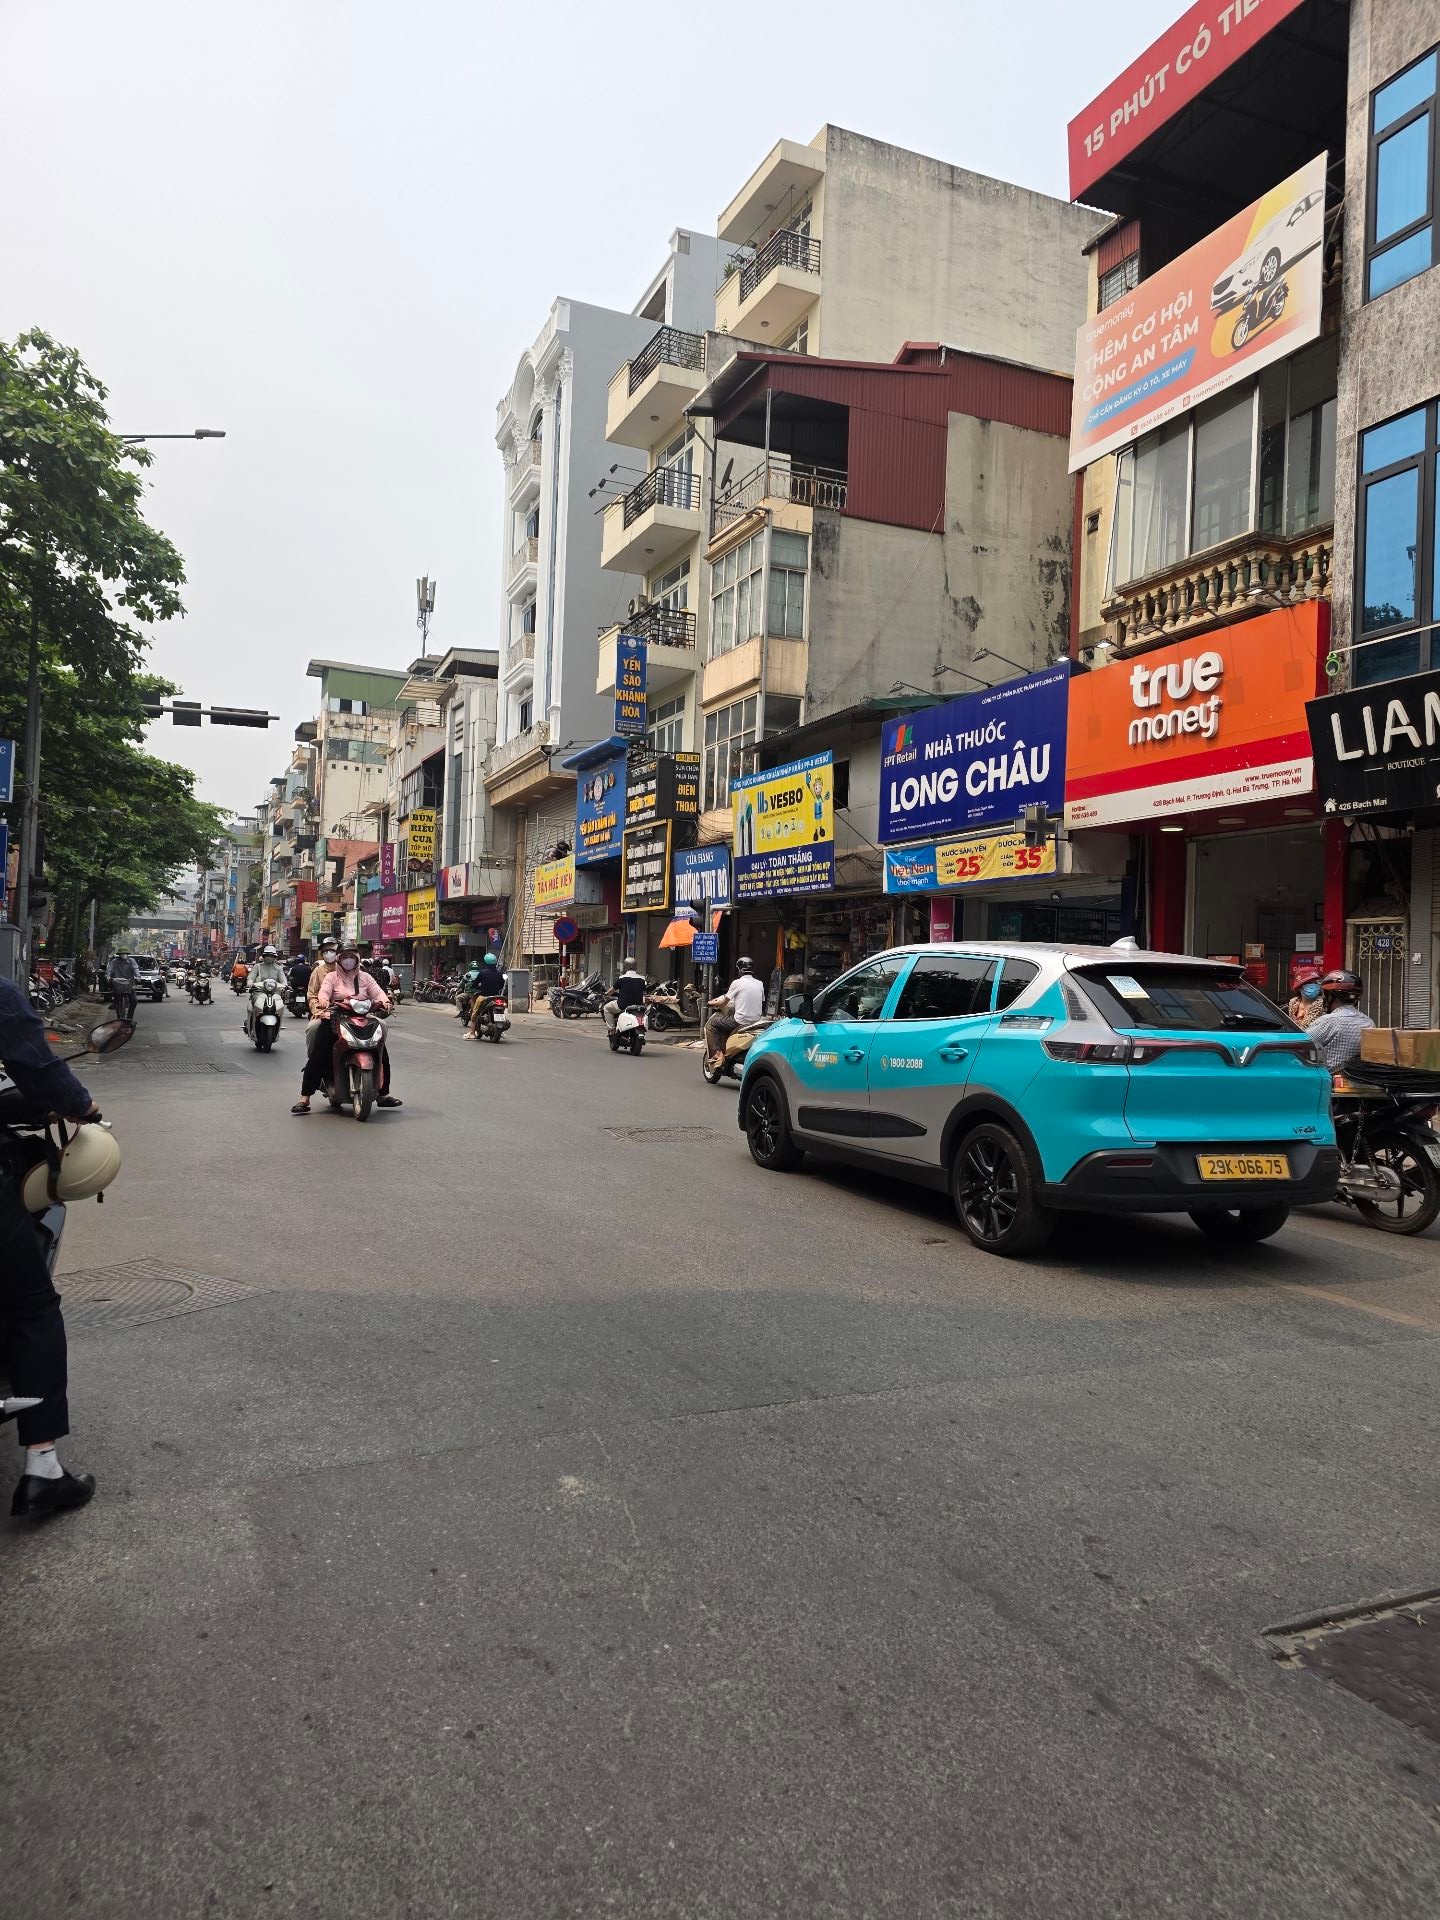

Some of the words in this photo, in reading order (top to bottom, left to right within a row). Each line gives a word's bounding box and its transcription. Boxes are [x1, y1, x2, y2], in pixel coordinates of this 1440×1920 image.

[1083, 122, 1105, 158] 15
[1109, 63, 1169, 137] PHÚT
[1175, 23, 1212, 75] CÓ
[1084, 333, 1128, 373] THÊM
[1131, 311, 1156, 343] CƠ
[1160, 289, 1193, 326] HỘI
[1082, 362, 1127, 402] CỘNG
[1130, 344, 1156, 374] AN
[1160, 315, 1199, 353] TÂM
[1161, 368, 1171, 380] XE
[623, 654, 641, 672] YẾN
[622, 672, 642, 687] SÀO
[1128, 651, 1224, 708] true
[616, 688, 647, 703] KHÁNH
[621, 702, 640, 719] HÒA
[1128, 694, 1223, 746] money
[924, 734, 954, 761] NHÀ
[955, 717, 1007, 752] THUỐC
[884, 755, 896, 768] FPT
[896, 748, 917, 765] Retail
[1387, 757, 1426, 771] BOUTIQUE
[889, 766, 959, 814] LONG
[965, 739, 1051, 797] CHÂU
[1244, 767, 1302, 783] www.truemoney.vn
[1281, 777, 1291, 787] Hà
[675, 800, 697, 814] THOẠI
[769, 787, 804, 811] VESBO
[1372, 797, 1388, 807] Mai
[411, 813, 434, 823] BÚN
[410, 823, 435, 833] RIÊU
[412, 834, 433, 844] CUA
[768, 853, 787, 868] TOÀN
[717, 863, 728, 898] BÒ
[1377, 938, 1390, 948] 428
[889, 1057, 905, 1069] 1900
[1207, 1159, 1283, 1176] 29K-066.75
